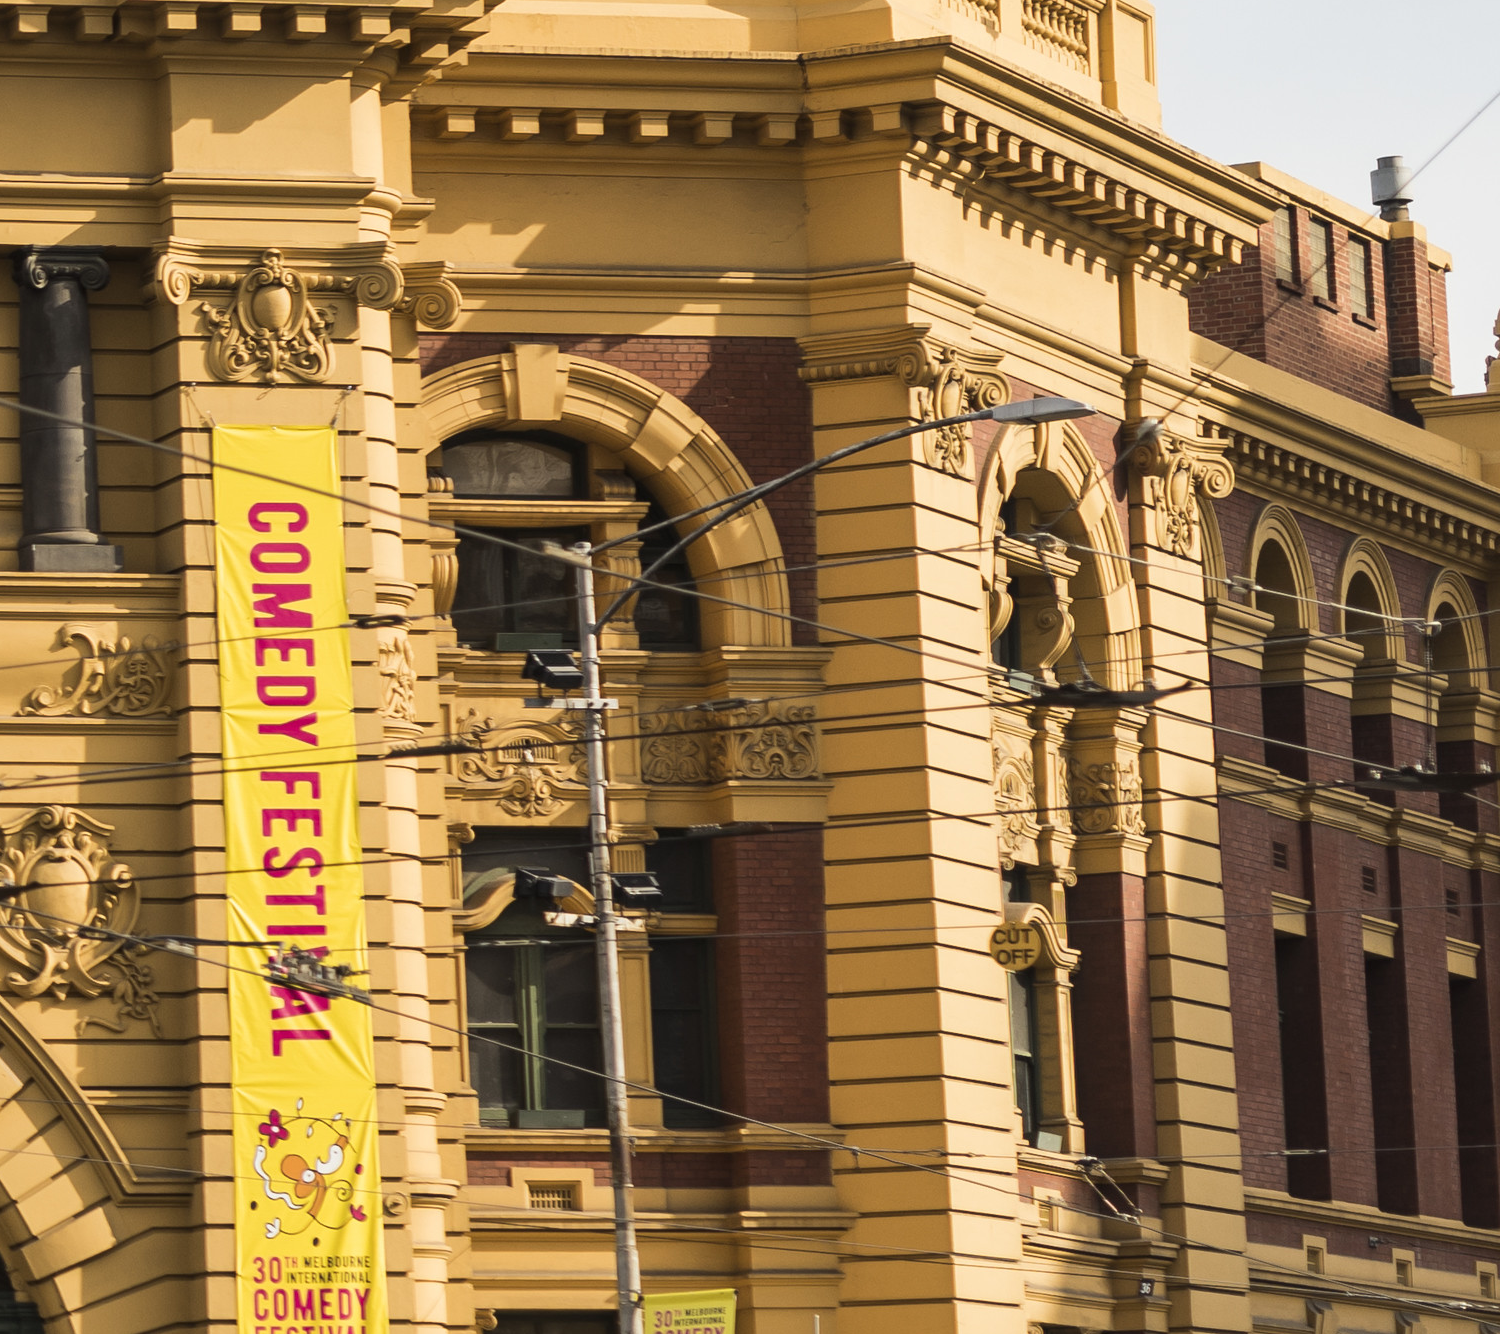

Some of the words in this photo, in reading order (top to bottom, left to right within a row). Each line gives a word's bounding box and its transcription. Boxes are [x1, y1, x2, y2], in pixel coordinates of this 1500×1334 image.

[248, 502, 319, 746] COMEDY
[304, 1256, 371, 1269] MELBOURNE
[287, 1272, 371, 1284] INTERNATIONAL
[254, 1288, 371, 1321] COMEDY
[684, 1307, 726, 1317] MELBOURNE
[674, 1316, 725, 1327] INTERNATIONAL
